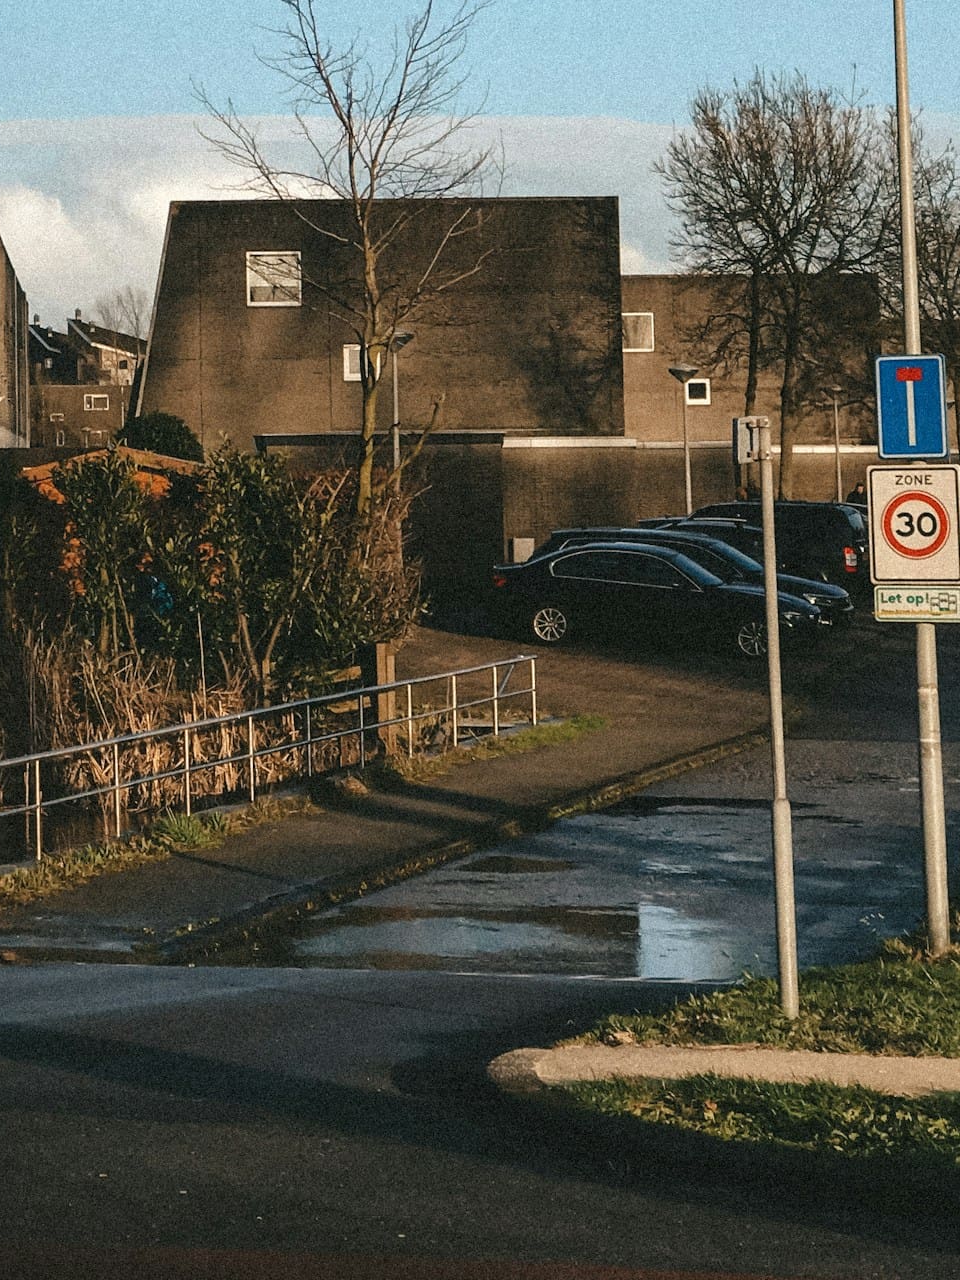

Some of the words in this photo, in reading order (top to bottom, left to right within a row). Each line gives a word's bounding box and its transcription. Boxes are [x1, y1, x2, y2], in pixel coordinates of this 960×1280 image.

[895, 475, 933, 485] ZONE
[896, 512, 937, 537] 30
[881, 592, 902, 603] Let
[906, 592, 929, 607] op!
